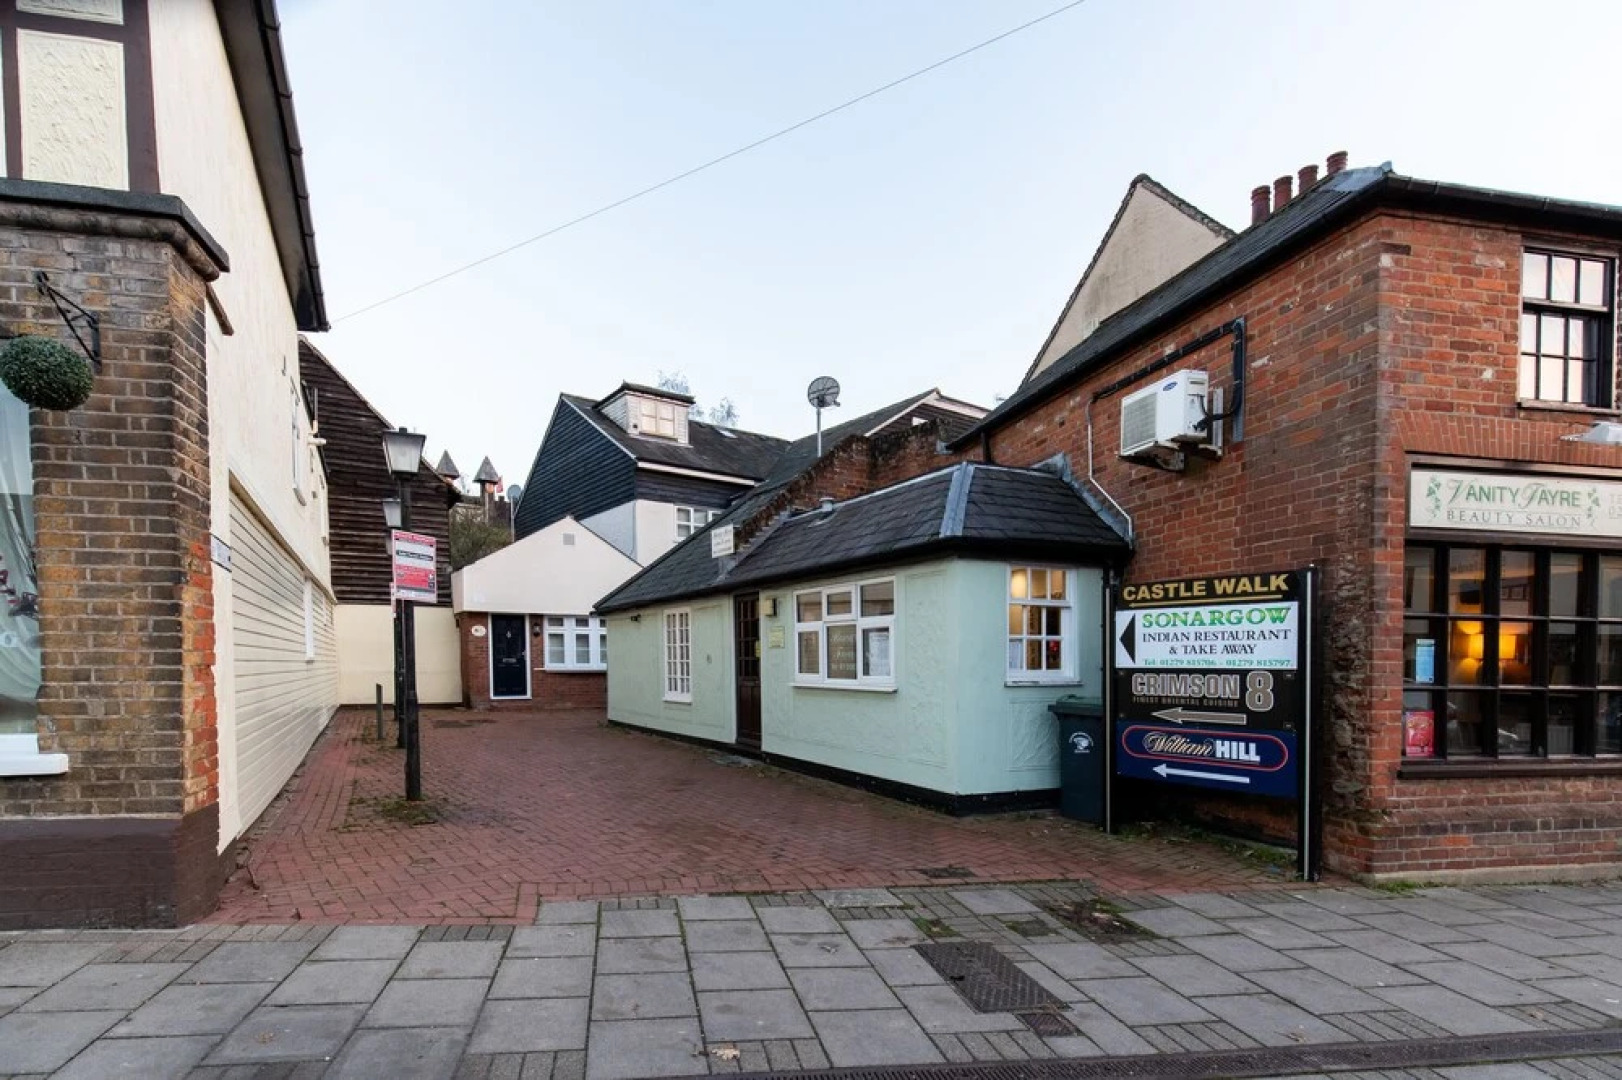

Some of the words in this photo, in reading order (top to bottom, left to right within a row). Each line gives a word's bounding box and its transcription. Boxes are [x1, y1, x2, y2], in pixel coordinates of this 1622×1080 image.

[1447, 478, 1519, 504] VANITY
[1518, 482, 1582, 509] FAYRE
[1447, 510, 1515, 524] BEAUTY
[1525, 513, 1582, 527] SALON
[1123, 580, 1207, 600] CASTLE
[1214, 574, 1289, 595] WALK
[1142, 607, 1292, 629] SONARGOW
[1143, 631, 1191, 643] INDIAN
[1194, 629, 1292, 642] RESTAURANT
[1169, 647, 1178, 655] &
[1181, 644, 1218, 655] TAKE
[1221, 643, 1258, 654] AWAY
[1131, 673, 1240, 699] CRIMSON
[1245, 670, 1274, 712] 8
[1142, 731, 1214, 757] William
[1215, 740, 1261, 762] HILL
